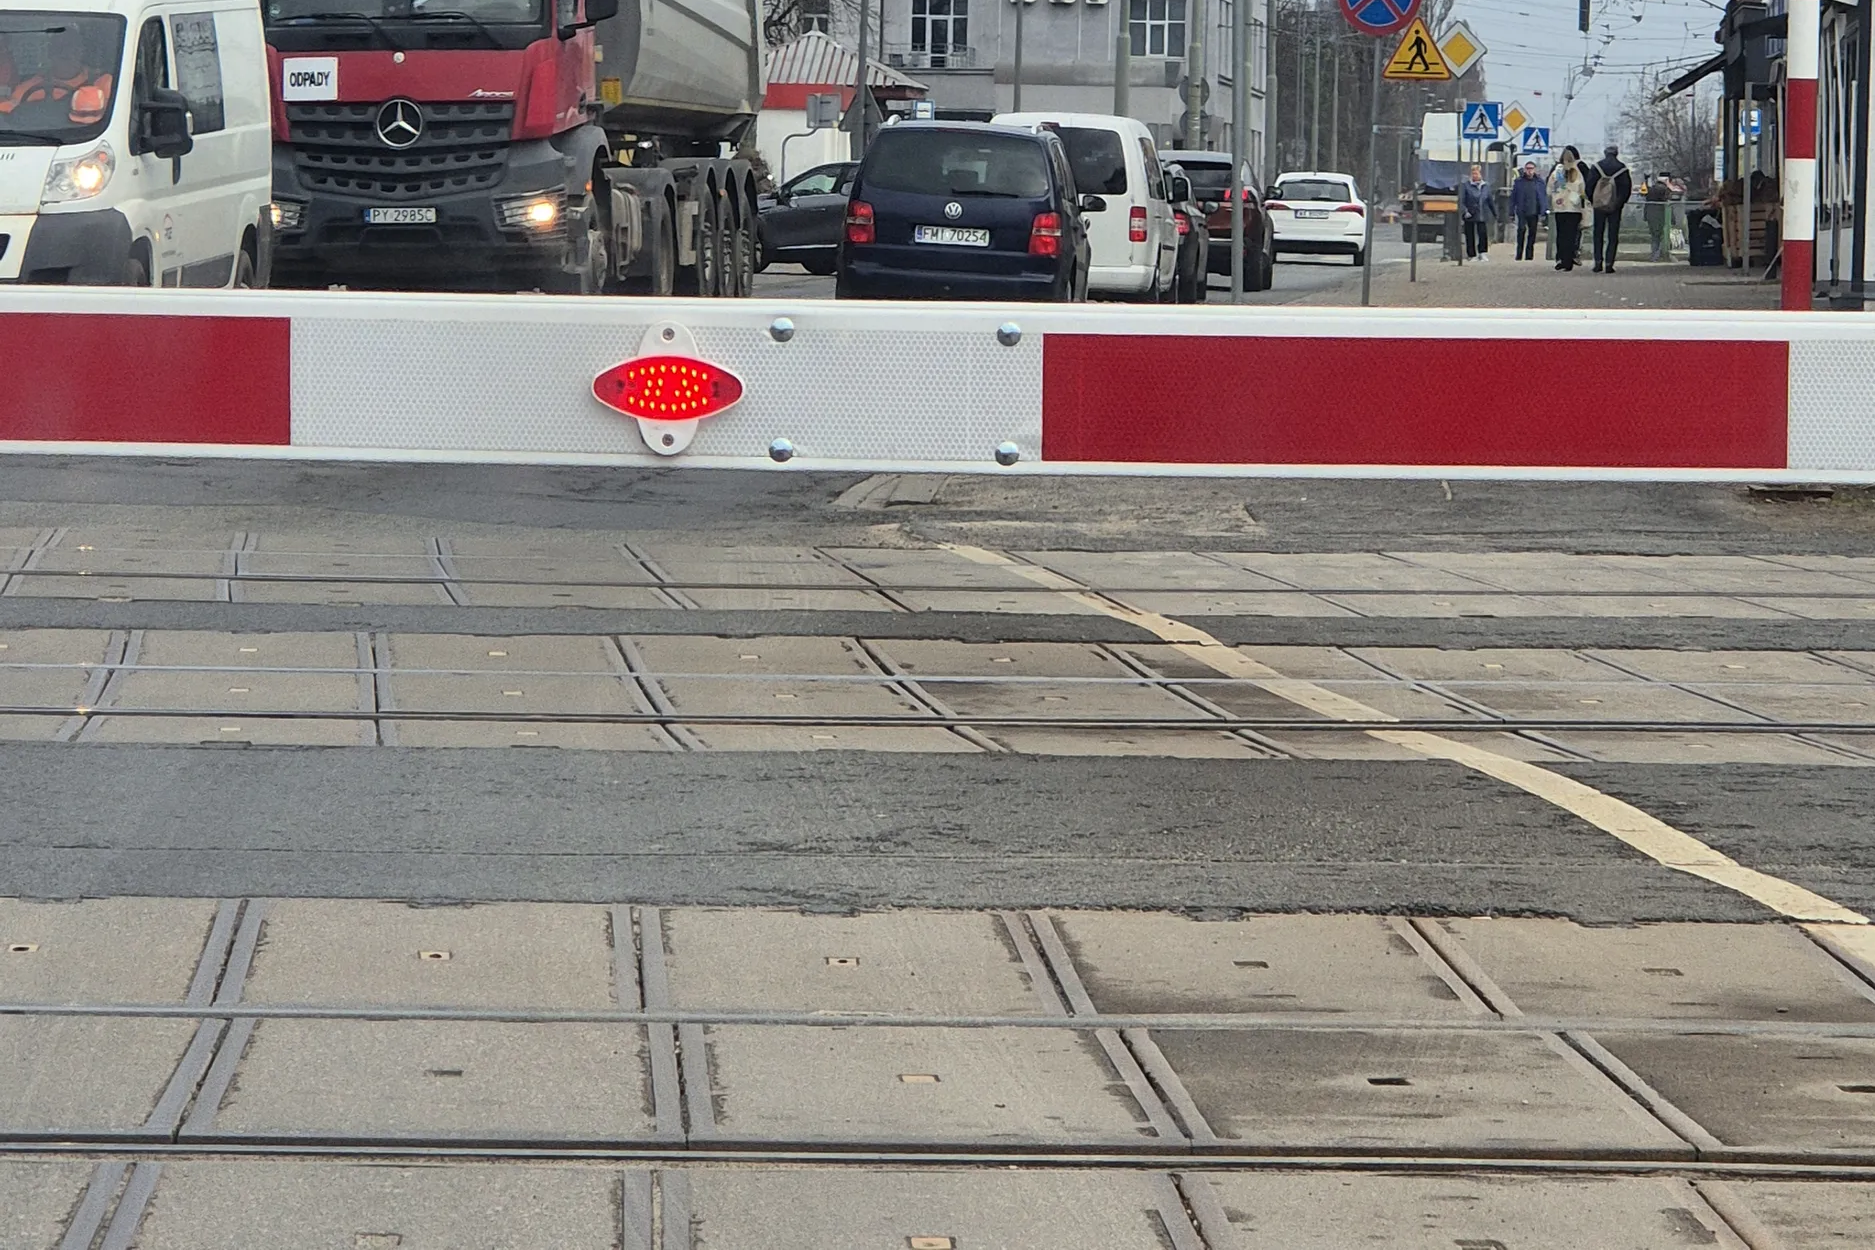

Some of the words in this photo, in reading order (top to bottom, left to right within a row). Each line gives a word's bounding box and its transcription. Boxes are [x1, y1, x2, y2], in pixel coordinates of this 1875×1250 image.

[289, 70, 331, 87] ODPADY
[372, 209, 389, 221] PY
[393, 209, 433, 221] 2985C
[923, 227, 945, 241] FMI
[949, 228, 988, 244] 70254
